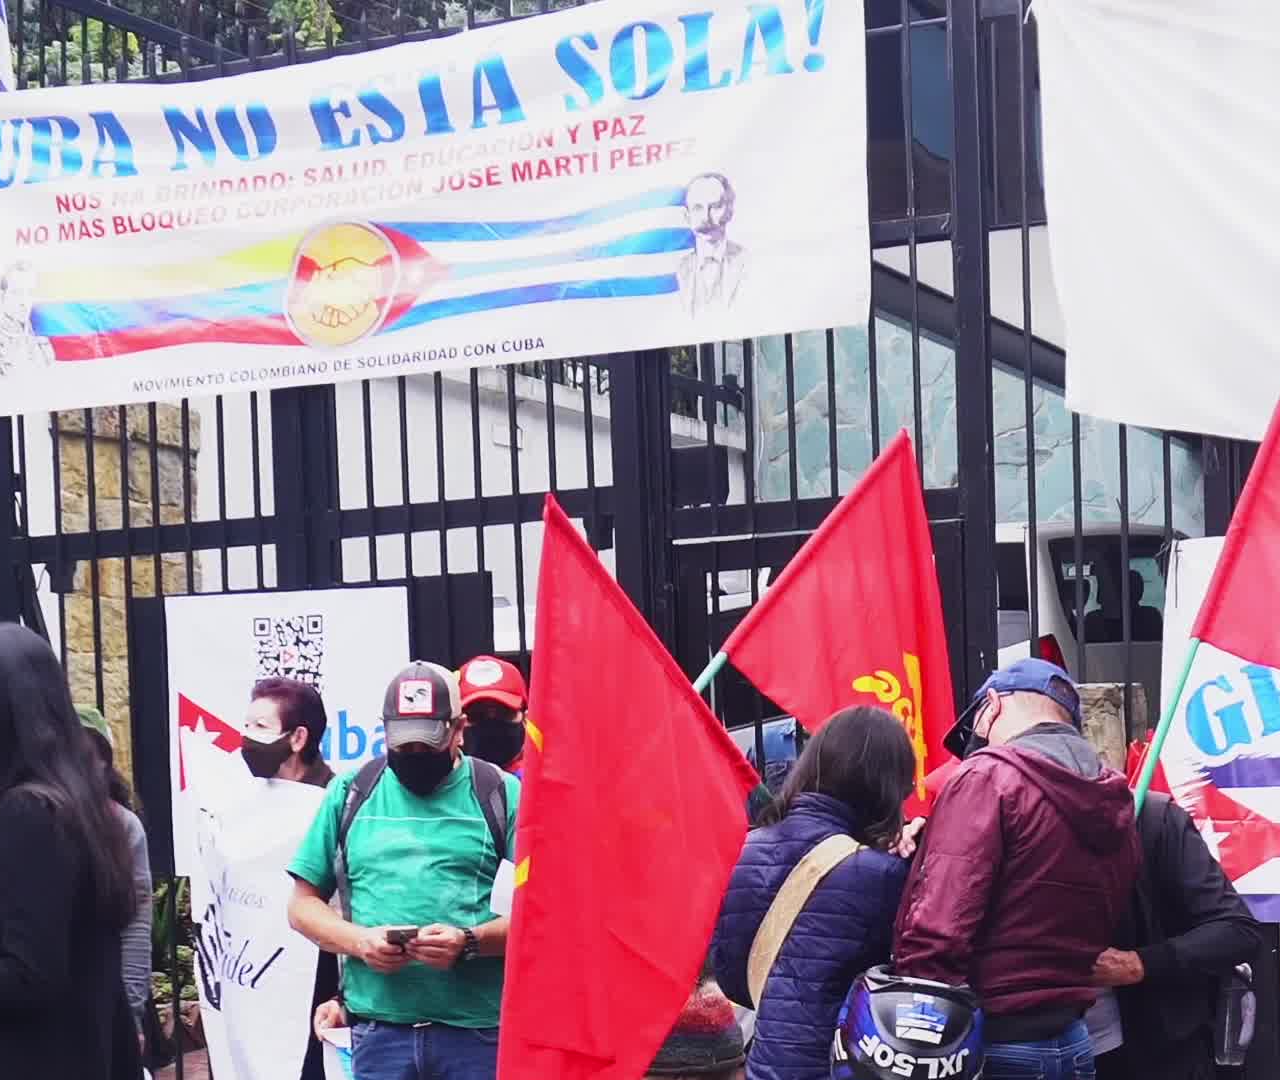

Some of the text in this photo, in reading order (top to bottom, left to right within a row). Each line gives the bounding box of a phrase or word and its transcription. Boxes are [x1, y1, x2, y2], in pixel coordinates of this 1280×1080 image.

[161, 101, 278, 170] NO
[555, 0, 825, 112] SOLA!
[55, 192, 102, 214] NOS
[567, 122, 582, 144] Y
[592, 114, 646, 142] PAZ
[16, 225, 49, 246] NO
[112, 205, 227, 236] BLOQUEO
[132, 336, 545, 393] MOVIMIENTO COLOMBIANO DE SOLIDARIDAD CON CUBA
[858, 1033, 969, 1080] JXL50F
